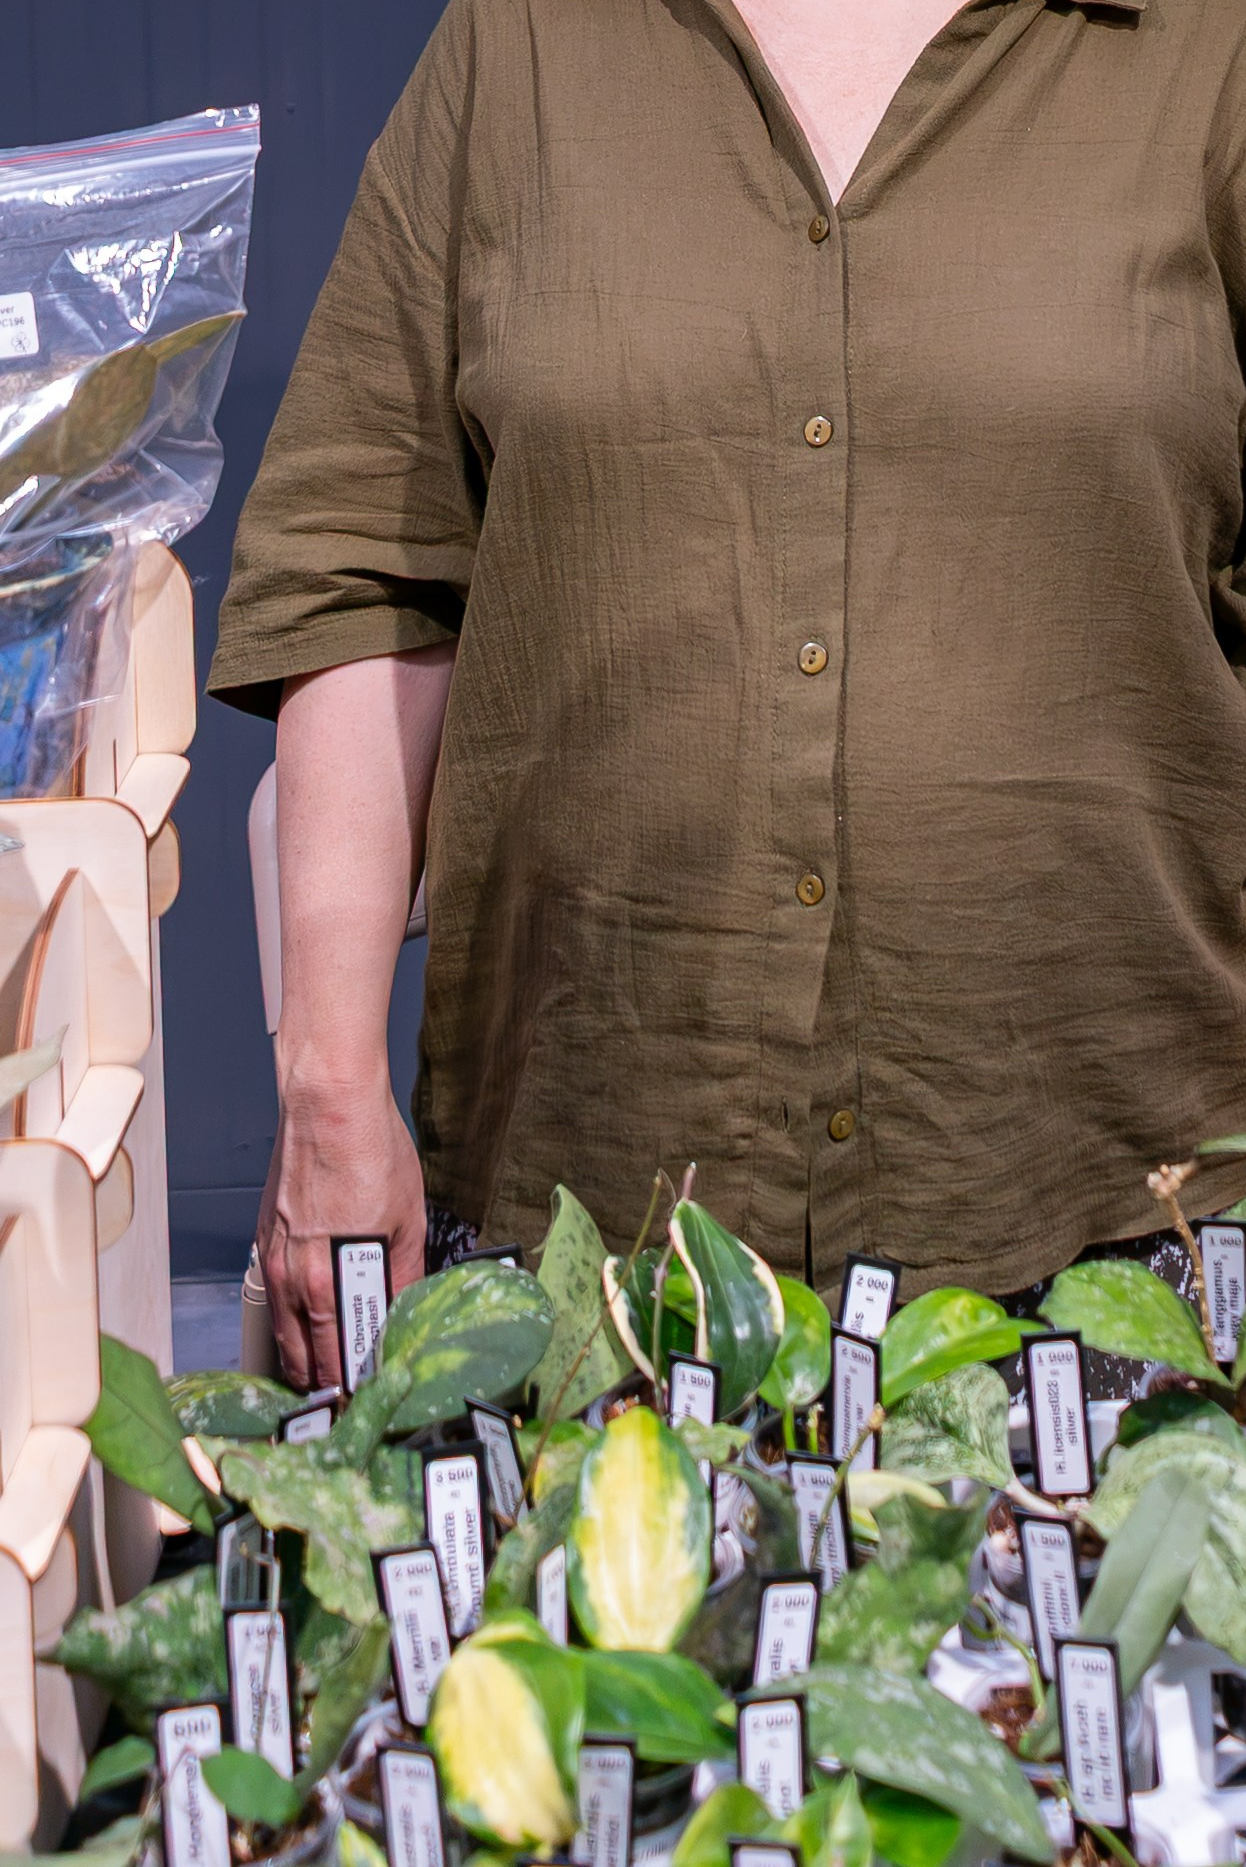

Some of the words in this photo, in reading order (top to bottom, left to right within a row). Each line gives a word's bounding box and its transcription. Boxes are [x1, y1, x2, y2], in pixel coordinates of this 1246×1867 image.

[0, 317, 25, 328] C196
[359, 1249, 382, 1262] 200
[353, 1293, 366, 1355] Obovata
[463, 1507, 479, 1556] silver
